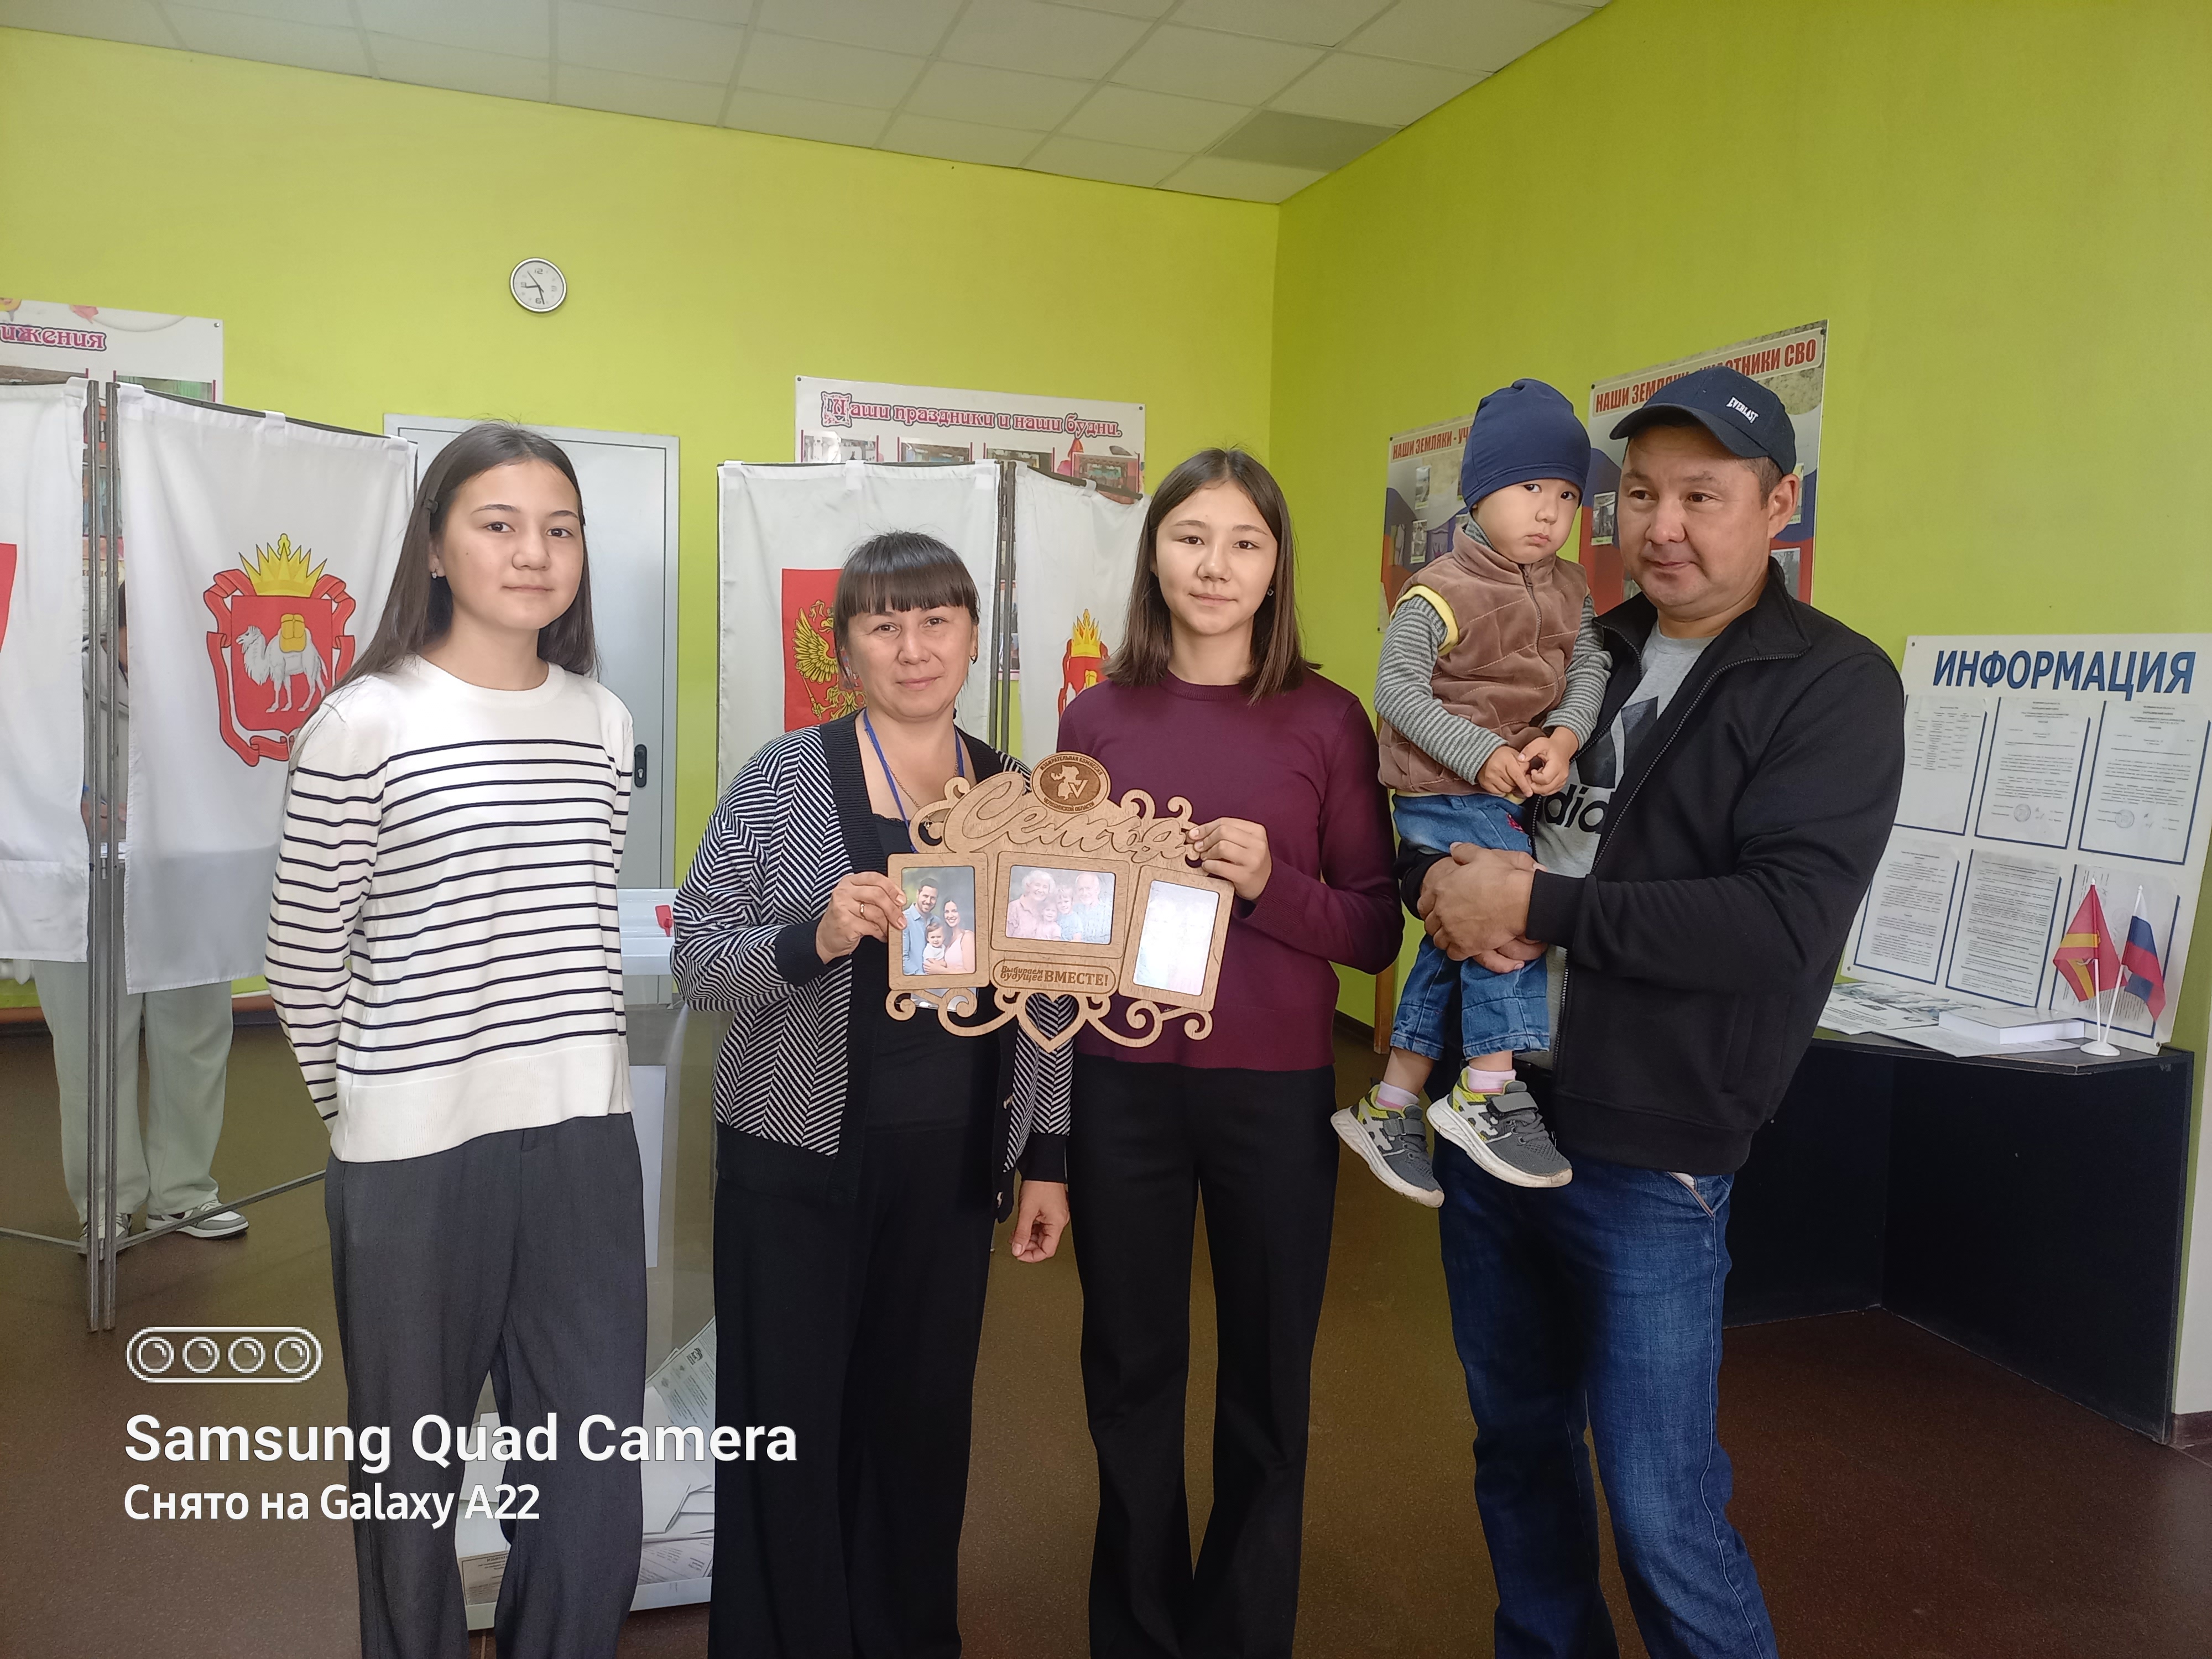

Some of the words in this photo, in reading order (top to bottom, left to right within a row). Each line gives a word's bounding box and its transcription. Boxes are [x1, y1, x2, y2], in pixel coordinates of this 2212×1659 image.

[1595, 387, 1630, 413] НАШИ
[1784, 338, 1817, 368] СВО
[822, 392, 890, 426] Наши
[894, 405, 995, 427] праздники
[998, 414, 1010, 429] и
[1014, 416, 1062, 432] наши
[1065, 414, 1122, 438] будни.
[1726, 396, 1759, 424] EVERLAST
[1392, 440, 1415, 460] НАШИ
[1415, 430, 1453, 455] ЗЕМЛЯКИ
[1933, 650, 2197, 701] ИНФОРМАЦИЯ
[944, 771, 1186, 863] Семья
[1000, 965, 1044, 975] Выбираем
[1000, 971, 1043, 983] будущее
[1044, 969, 1109, 987] ВМЕСТЕ!
